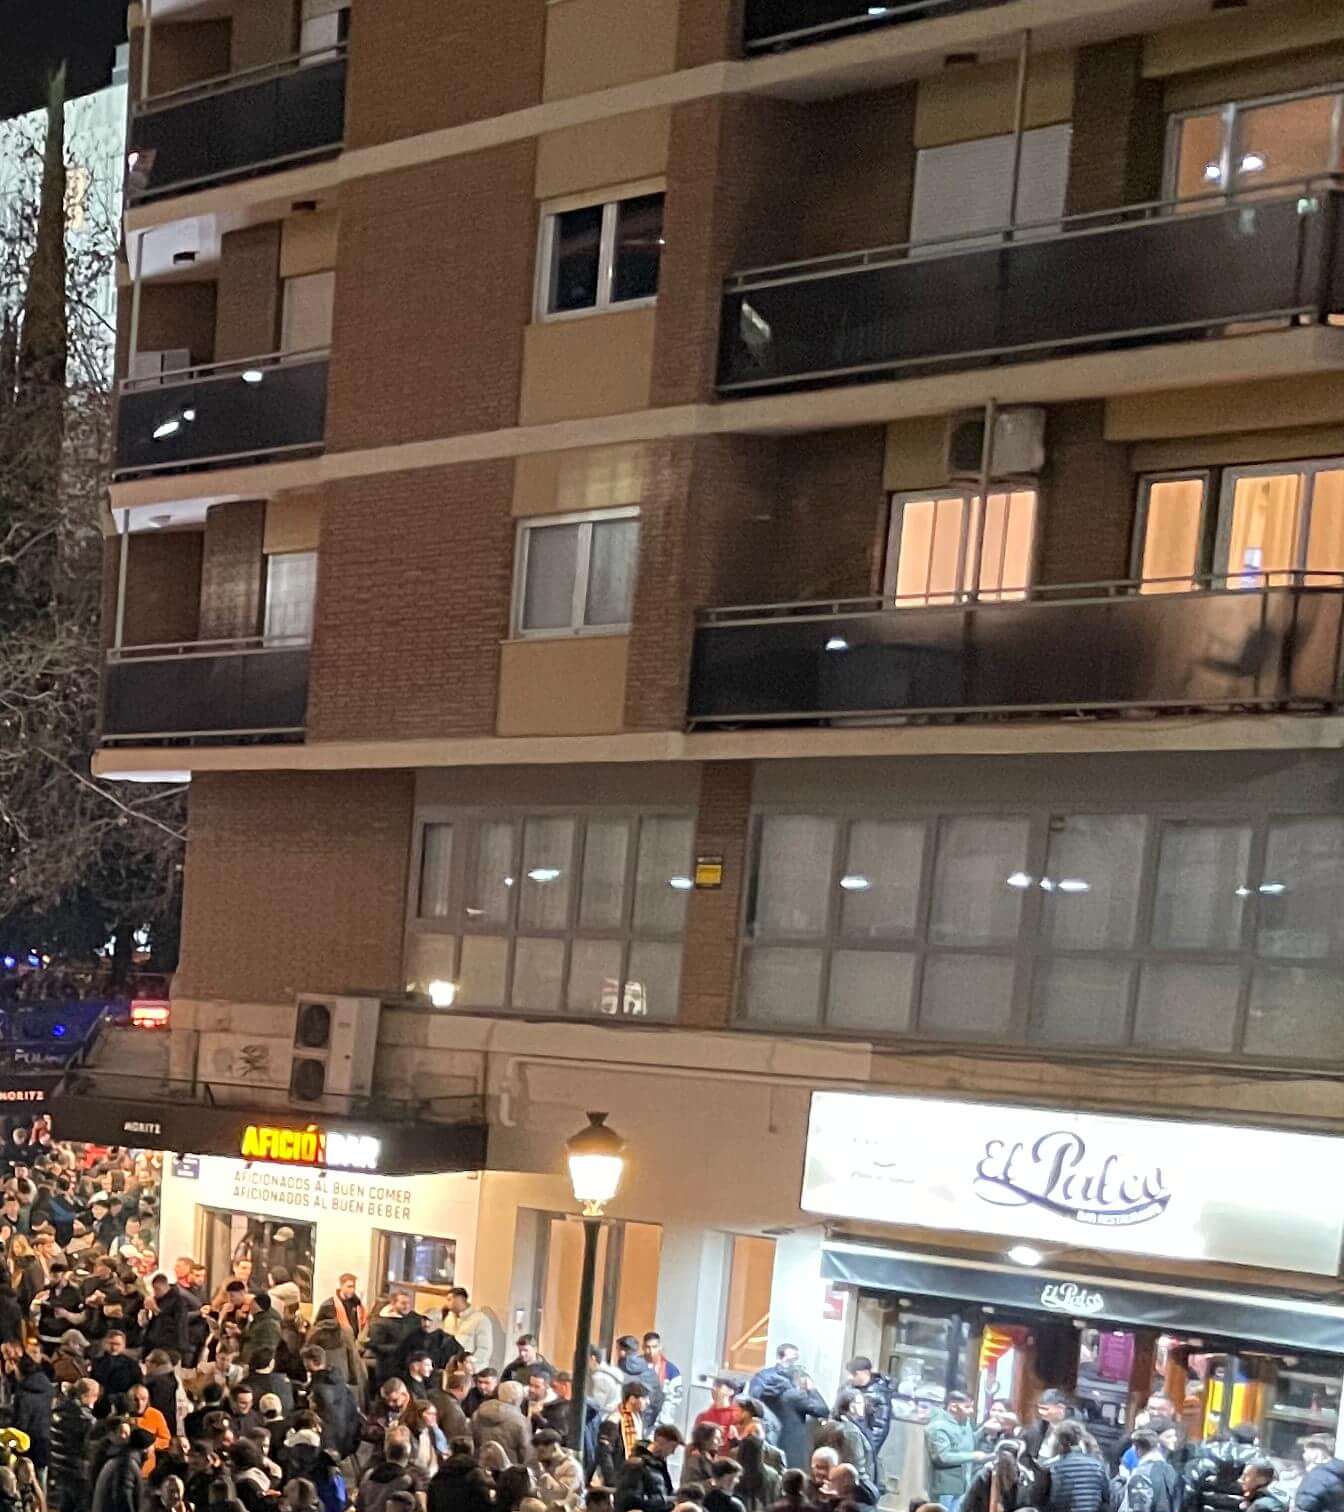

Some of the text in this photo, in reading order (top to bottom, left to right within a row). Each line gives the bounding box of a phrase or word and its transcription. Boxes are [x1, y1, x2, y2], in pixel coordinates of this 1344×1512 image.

[123, 1121, 162, 1135] MORITZ
[976, 1139, 1024, 1183] El
[1032, 1131, 1166, 1206] Palco
[233, 1186, 411, 1220] AFICIONADOS AL BUEN BEBER
[234, 1170, 412, 1204] AFICIONADOS AL BUEN COMER
